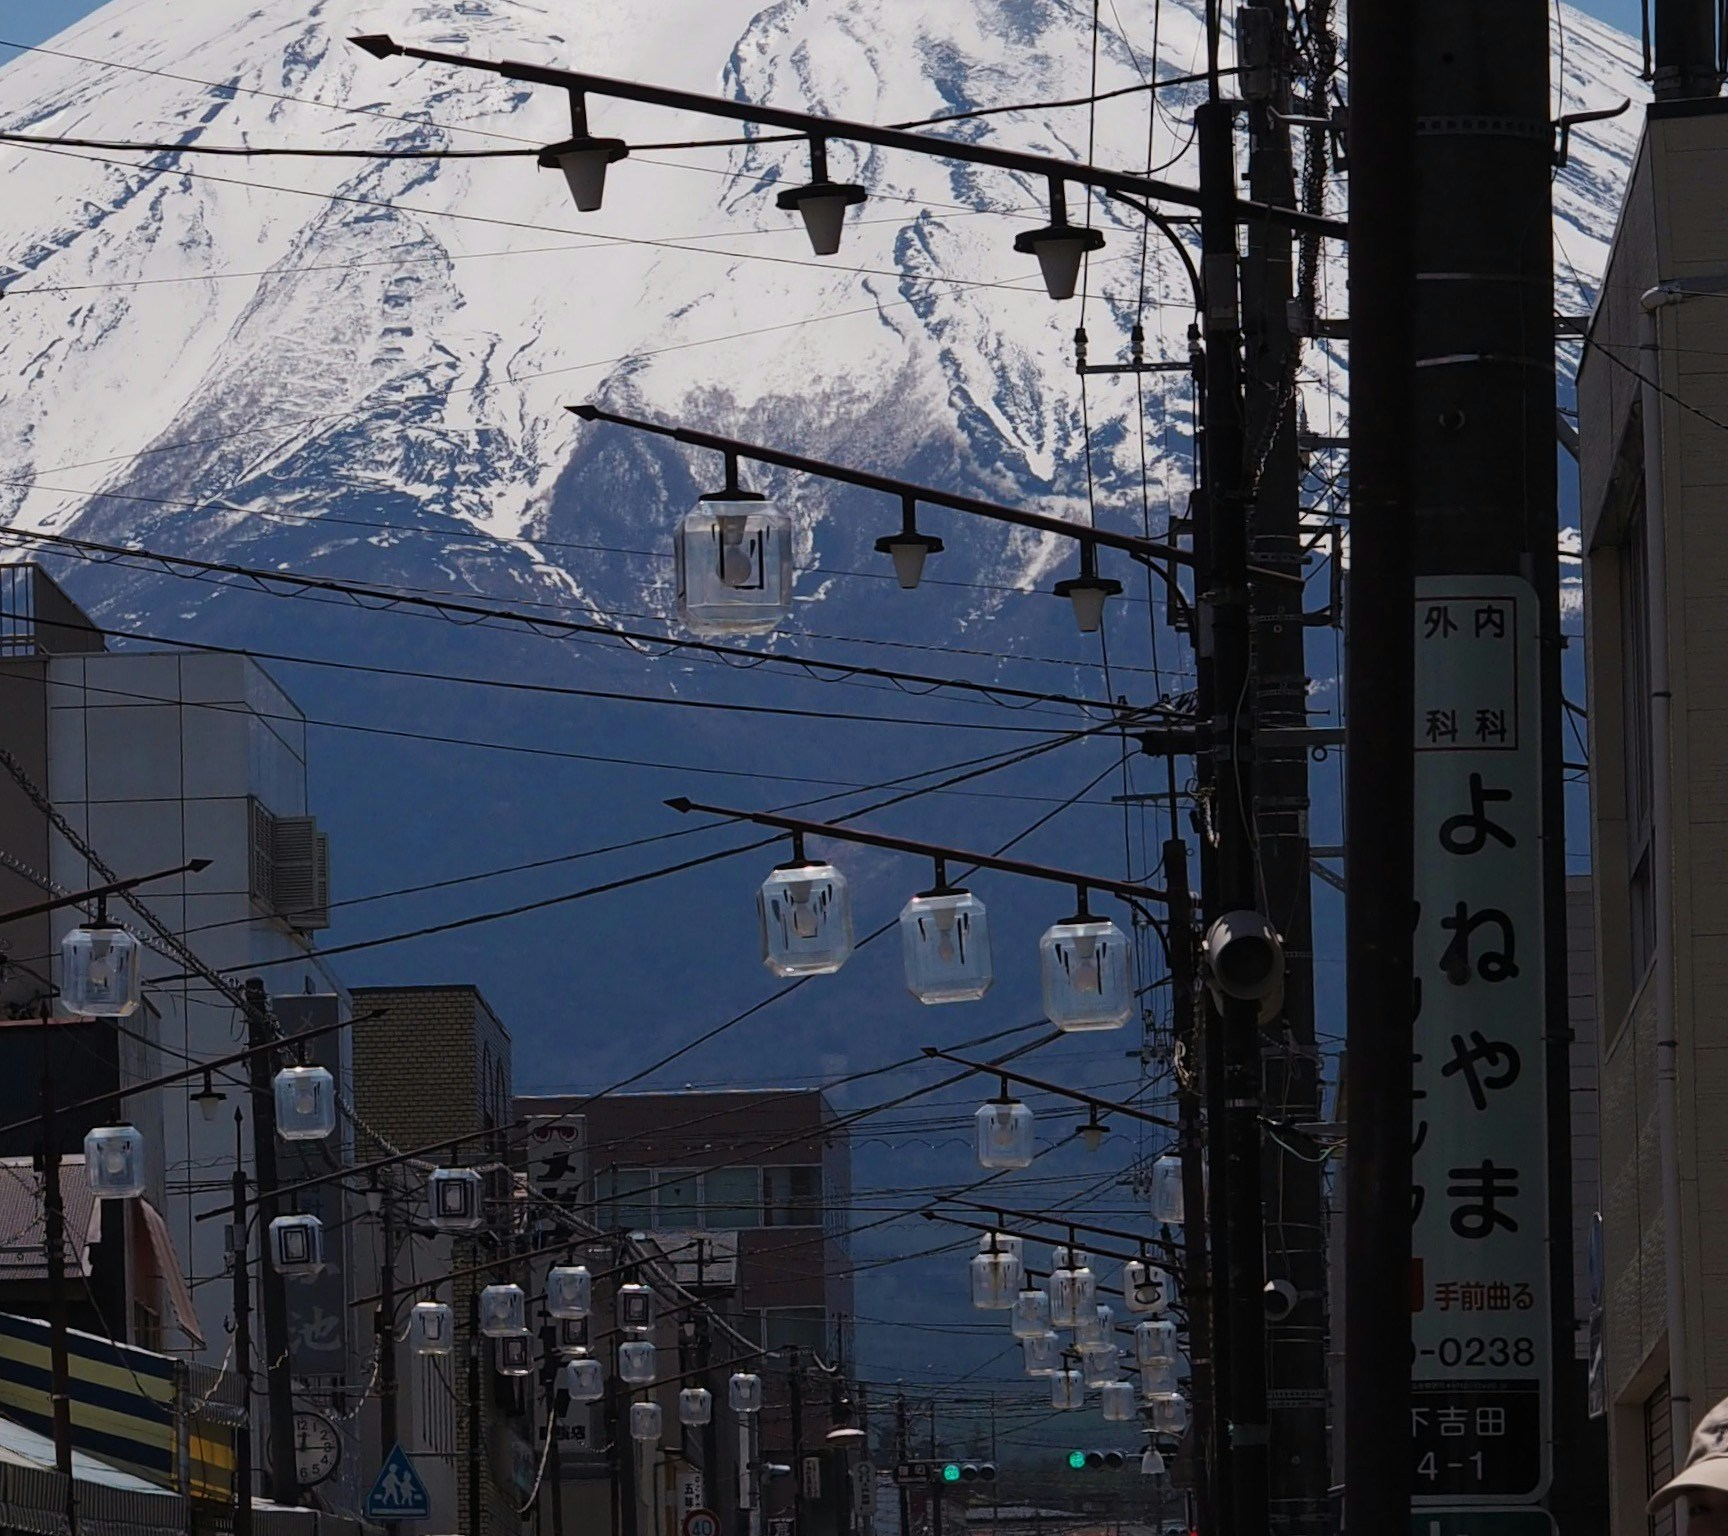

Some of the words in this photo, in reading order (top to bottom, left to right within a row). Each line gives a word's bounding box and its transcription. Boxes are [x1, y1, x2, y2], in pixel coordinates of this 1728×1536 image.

[1424, 606, 1458, 742] 外科
[1475, 605, 1507, 742] 内科
[1439, 772, 1520, 1239] よねやま
[1435, 1281, 1534, 1311] 手前曲る
[1410, 1337, 1535, 1366] -0238
[1410, 1405, 1506, 1438] 下吉田
[1416, 1450, 1483, 1481] 4-1
[692, 1520, 712, 1536] 40
